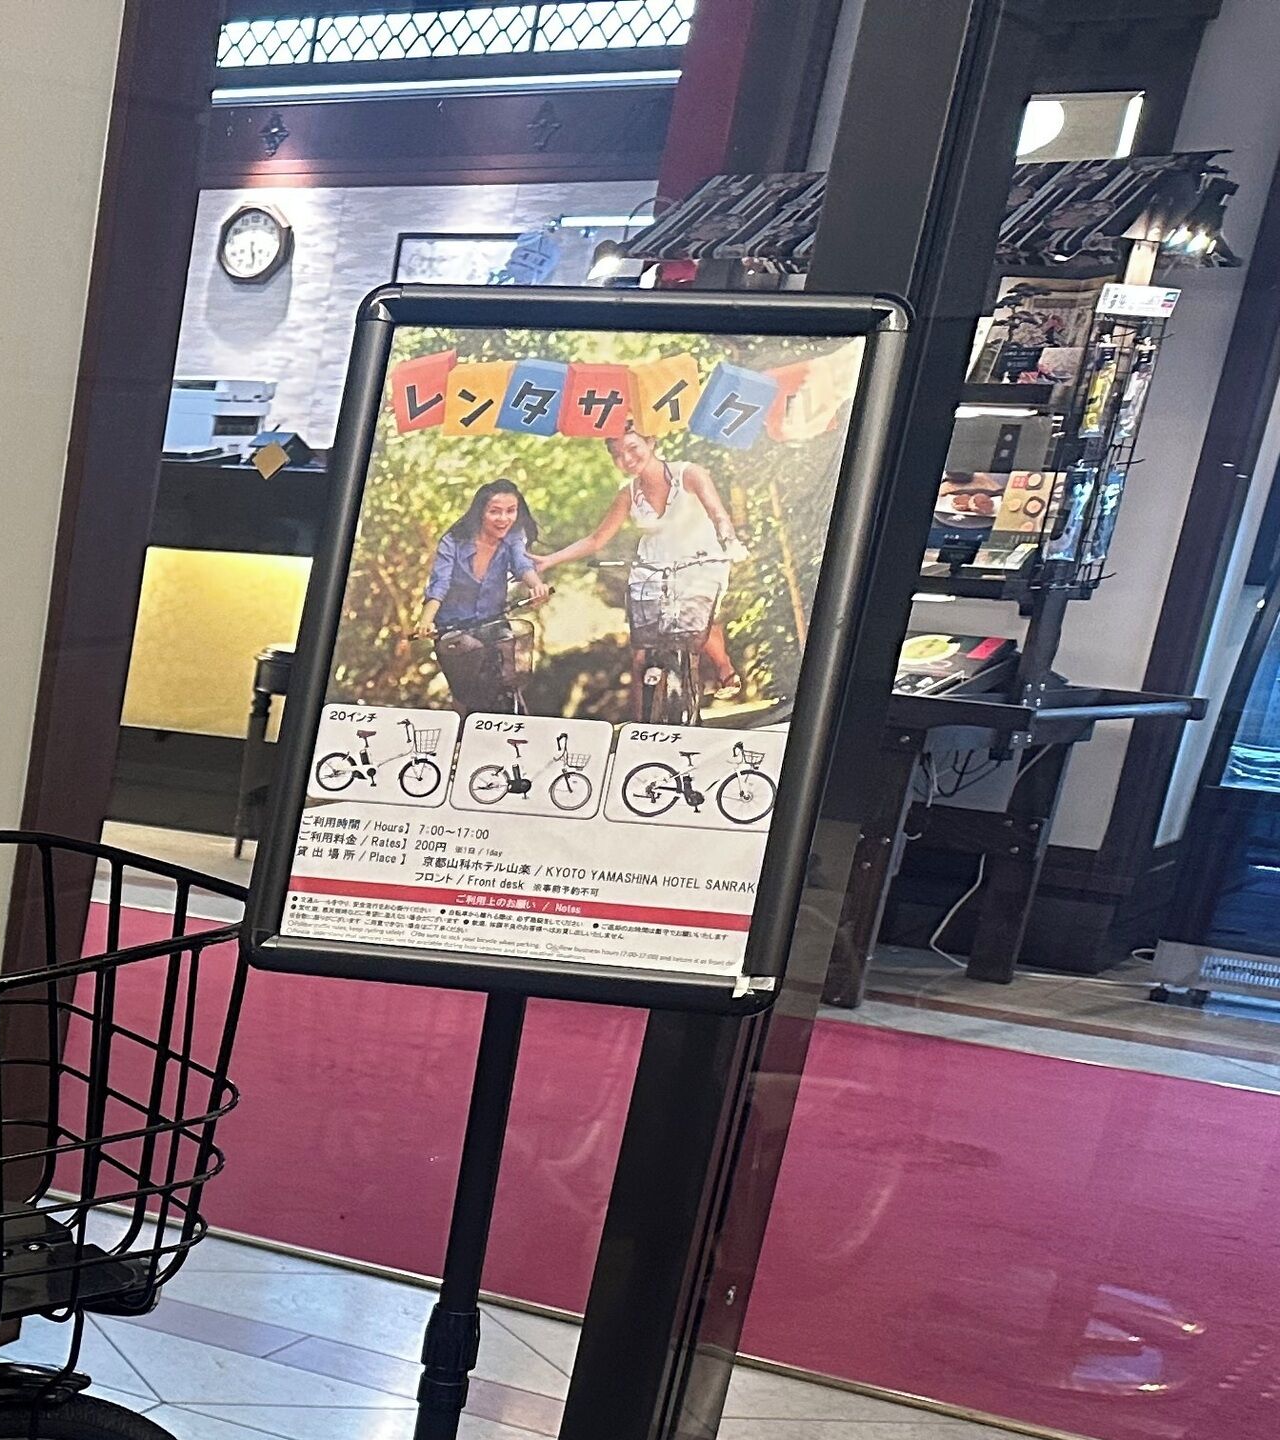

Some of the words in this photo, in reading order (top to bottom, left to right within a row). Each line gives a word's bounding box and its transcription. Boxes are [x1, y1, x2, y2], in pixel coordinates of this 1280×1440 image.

[404, 378, 828, 437] レンタサイクル
[330, 710, 377, 723] 20インチ
[475, 719, 526, 733] 20インチ
[630, 730, 683, 744] 26インチ
[415, 839, 448, 853] 200円
[422, 855, 532, 876] 京都山科ホテル山楽
[545, 866, 586, 880] KYOTO
[590, 870, 659, 887] YAMASHINA
[662, 876, 701, 889] HOTEL
[414, 872, 453, 884] フロント
[467, 876, 496, 889] Front
[499, 879, 524, 891] desk
